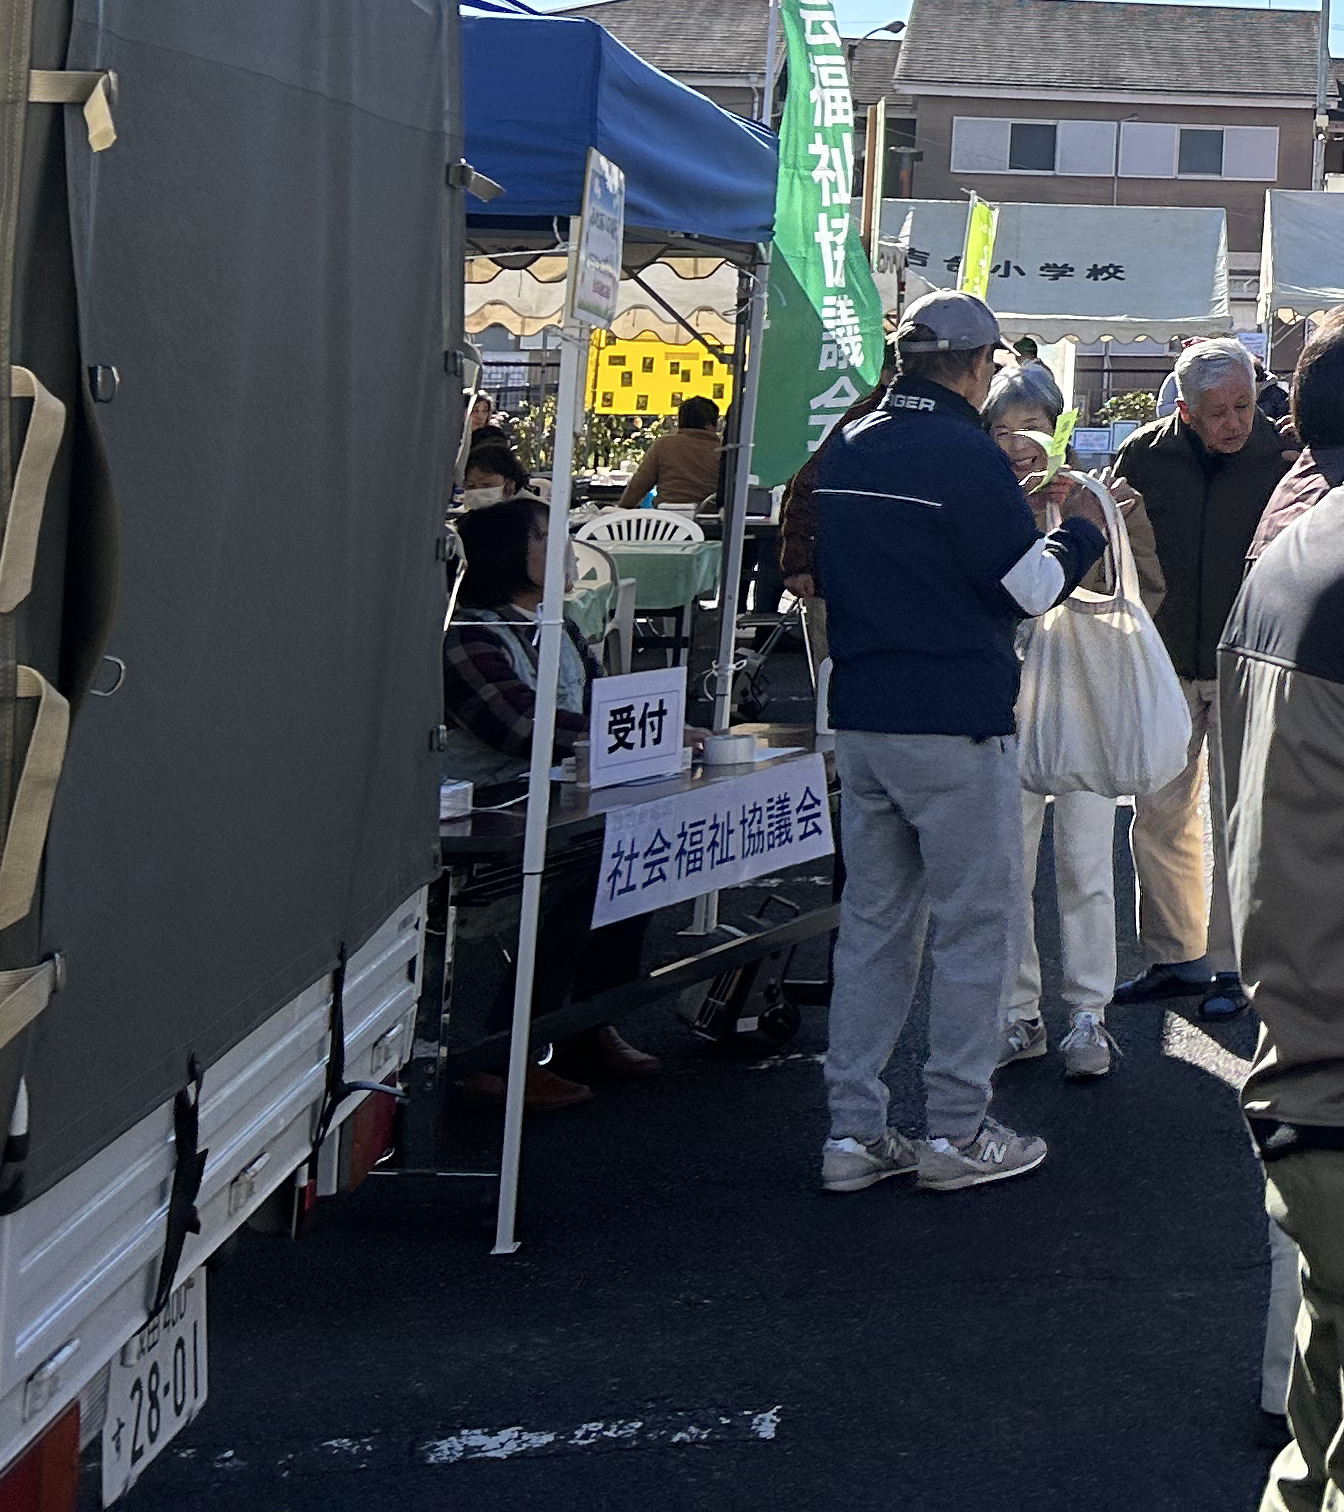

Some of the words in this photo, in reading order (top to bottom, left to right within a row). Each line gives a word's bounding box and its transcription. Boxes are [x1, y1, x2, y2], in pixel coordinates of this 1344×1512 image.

[607, 698, 668, 765] 受付
[606, 785, 824, 901] 社会福祉協議会
[130, 1319, 199, 1468] 28-01
